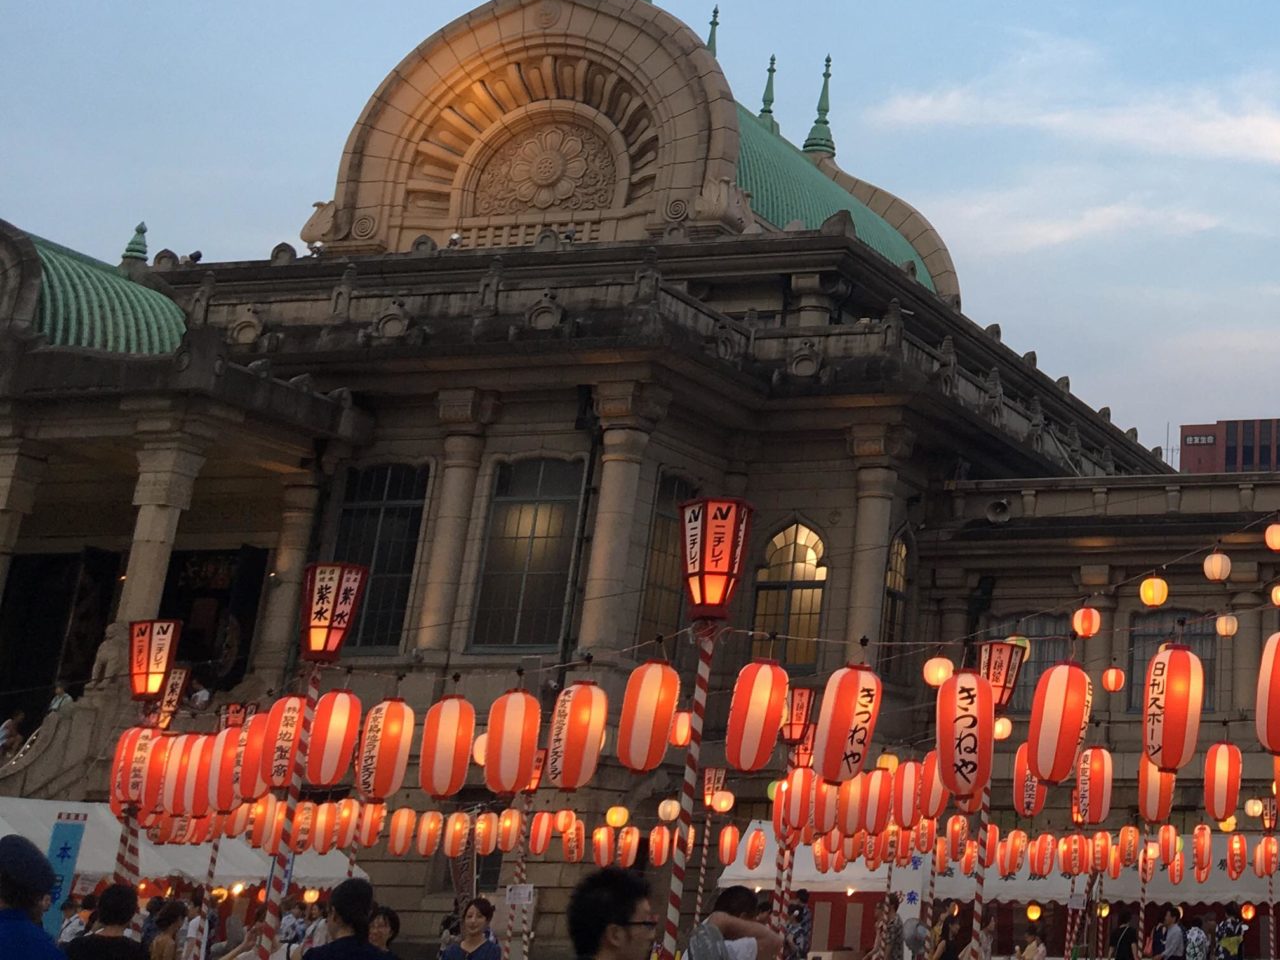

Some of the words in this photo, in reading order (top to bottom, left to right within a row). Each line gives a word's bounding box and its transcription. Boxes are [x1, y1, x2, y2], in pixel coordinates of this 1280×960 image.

[690, 526, 699, 570] ニチレイ
[711, 525, 726, 568] ニチレイ
[313, 583, 332, 621] 紫水
[333, 586, 355, 625] 紫水
[155, 638, 166, 669] ニチレイ
[842, 687, 876, 773] きつねや
[1147, 661, 1166, 757] 日刊スポーツ
[953, 686, 978, 784] きつねや
